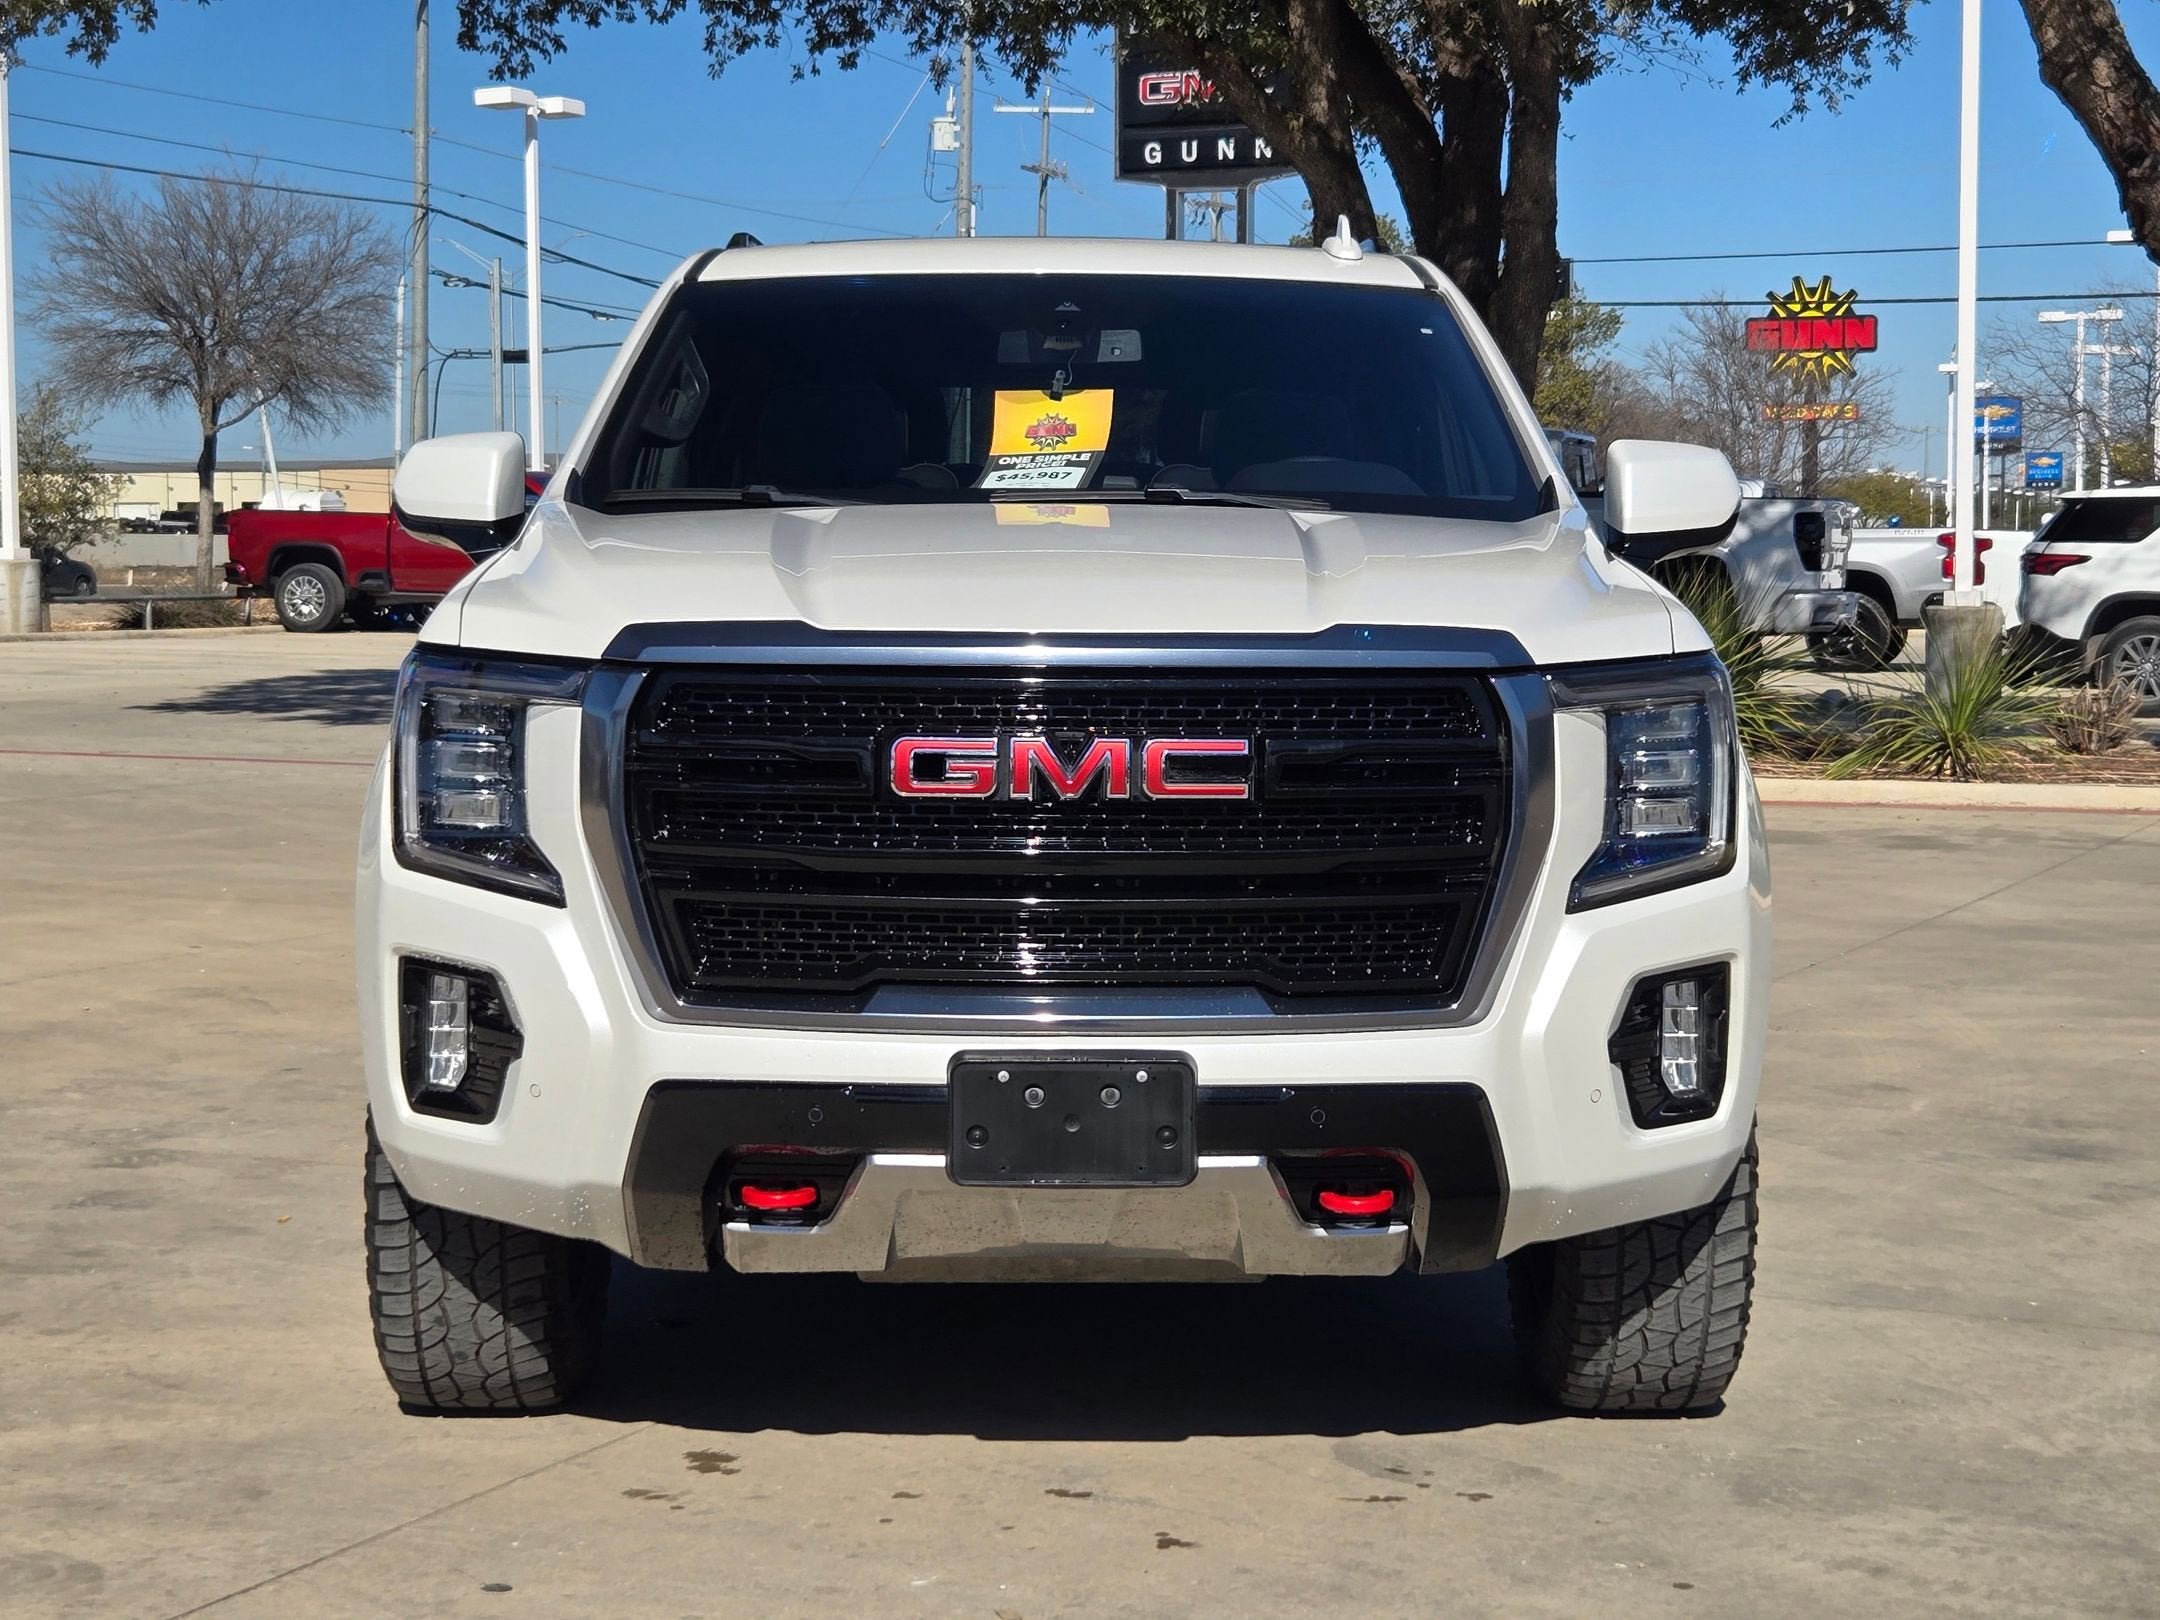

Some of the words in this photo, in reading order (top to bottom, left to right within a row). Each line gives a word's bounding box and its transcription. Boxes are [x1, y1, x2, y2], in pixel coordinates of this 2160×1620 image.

[1139, 69, 1217, 106] GM
[1144, 137, 1273, 165] GUNN
[1748, 318, 1876, 350] GUNN
[998, 456, 1032, 465] ONE
[1036, 453, 1091, 463] SIMPLE
[1015, 461, 1067, 469] PRICE!
[994, 472, 1072, 482] $45,987
[890, 736, 1250, 799] GMC
